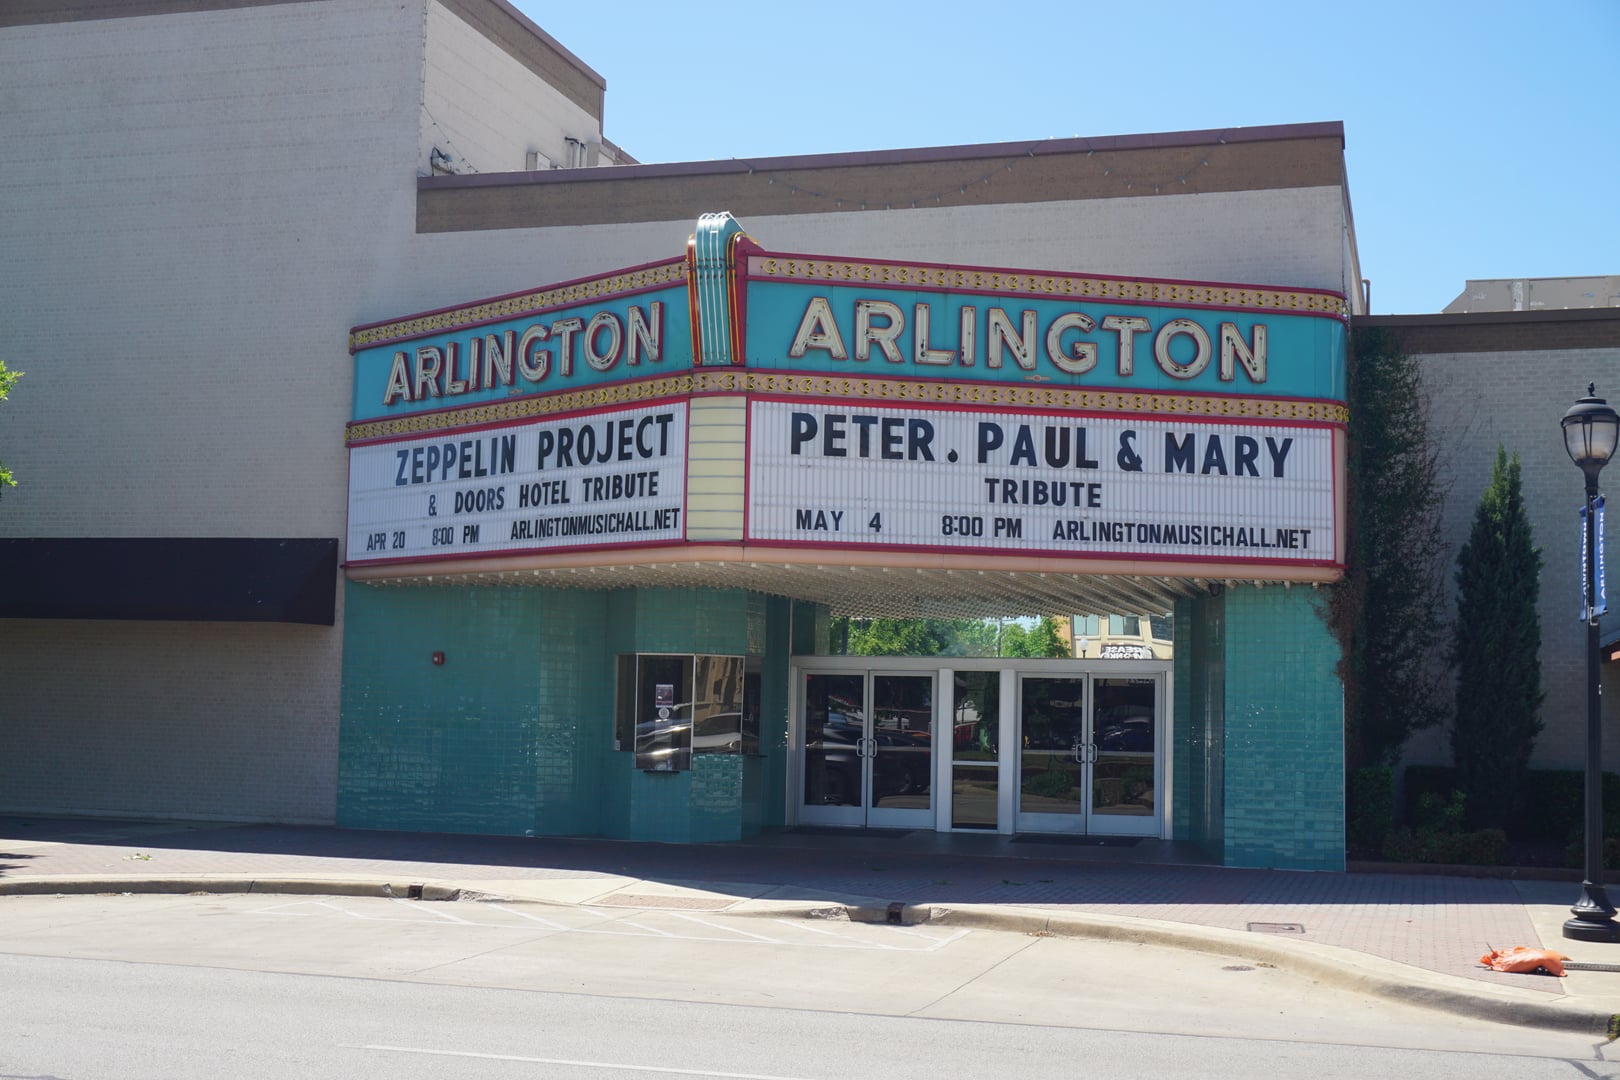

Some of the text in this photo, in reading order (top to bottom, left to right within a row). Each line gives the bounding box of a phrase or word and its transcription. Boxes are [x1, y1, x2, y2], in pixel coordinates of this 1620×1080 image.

[383, 301, 664, 406] ARLINGTON
[789, 296, 1268, 384] ARLINGTON
[395, 413, 674, 486] ZEPPELIN PROJECT
[977, 421, 1099, 469] PAUL
[1116, 429, 1143, 472] &
[1164, 431, 1294, 478] MARY
[428, 471, 659, 517] & DOORS HOTEL TRIBUTE
[984, 477, 1102, 508] TRIBUTE
[366, 508, 680, 551] APR 20 8:00 PM ARLINGTONMUSICHALL.NET
[796, 509, 1312, 549] MAY 4 8:00 PM ARLINGTONMUSICHALL.NET
